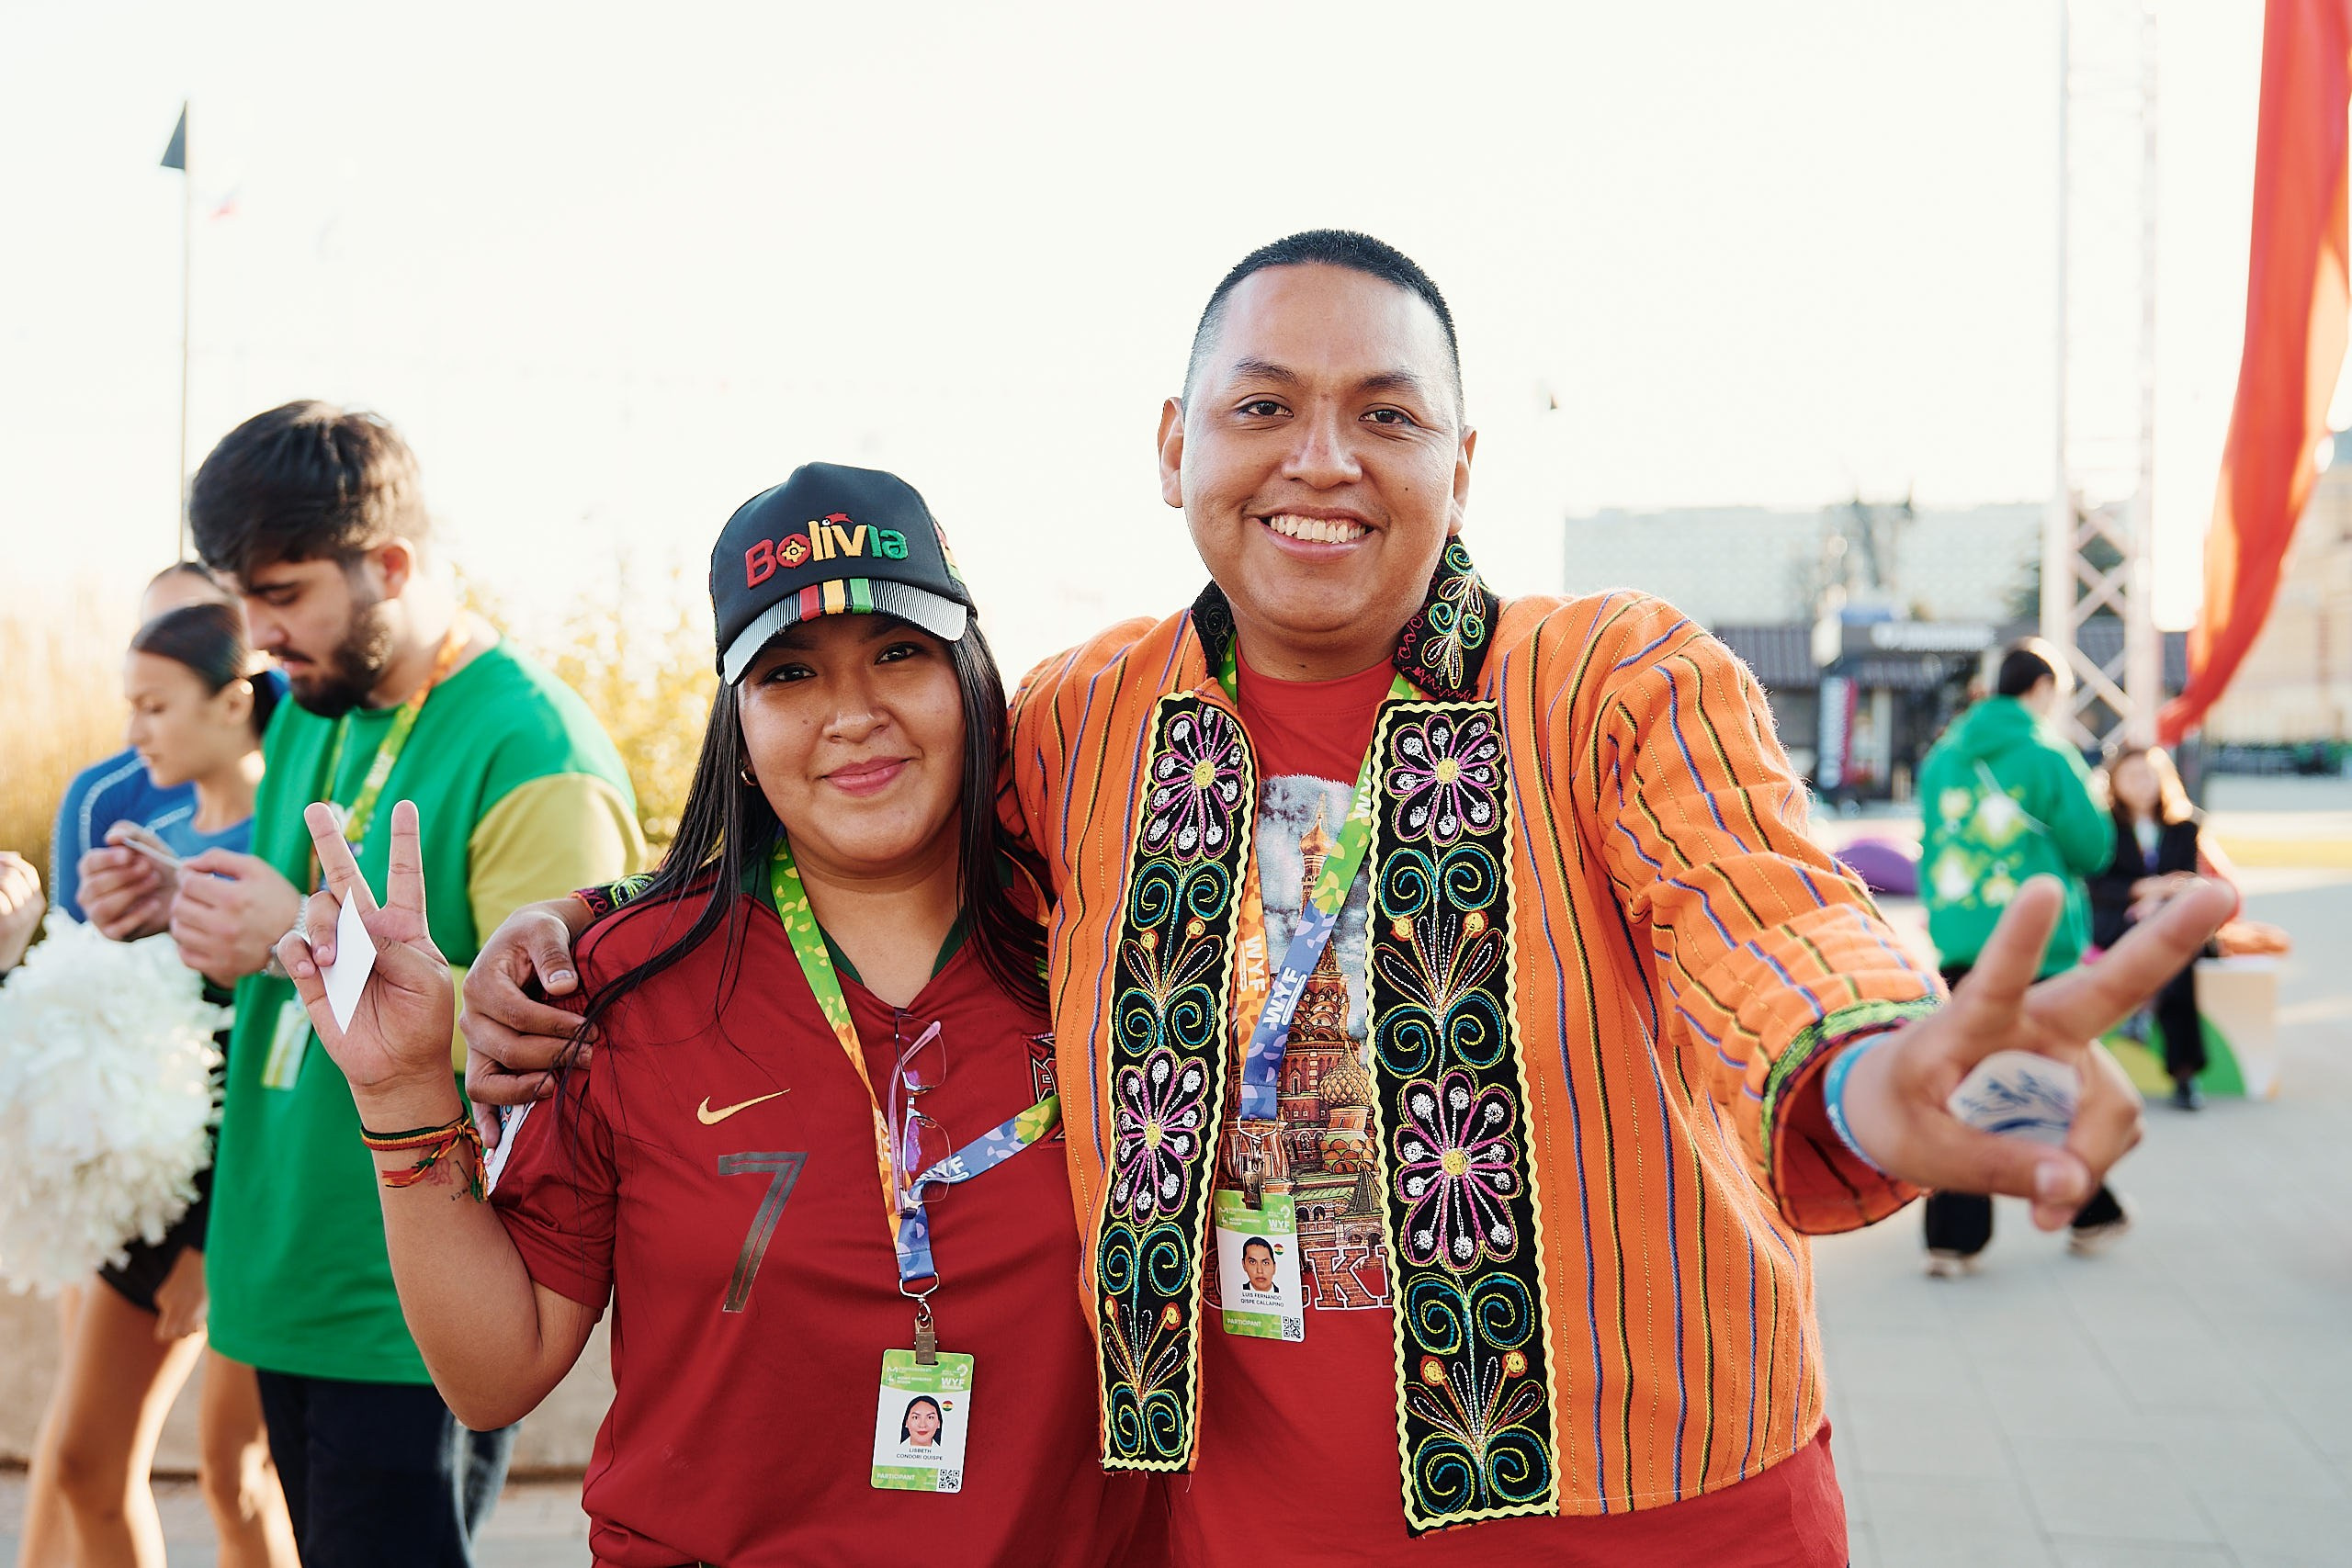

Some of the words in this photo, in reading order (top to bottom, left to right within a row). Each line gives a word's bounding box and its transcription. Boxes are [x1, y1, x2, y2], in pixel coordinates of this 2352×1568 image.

[745, 518, 909, 589] Bolivia
[1352, 761, 1372, 818] WY
[1245, 935, 1266, 991] WYF
[1263, 966, 1299, 1023] WYF
[718, 1151, 808, 1313] 7
[1268, 1219, 1290, 1229] WYF
[1254, 1292, 1282, 1301] FERNANDO
[1227, 1318, 1262, 1327] PARTICIPANT
[941, 1377, 965, 1386] WYF
[876, 1472, 916, 1481] PARTICIPANT
